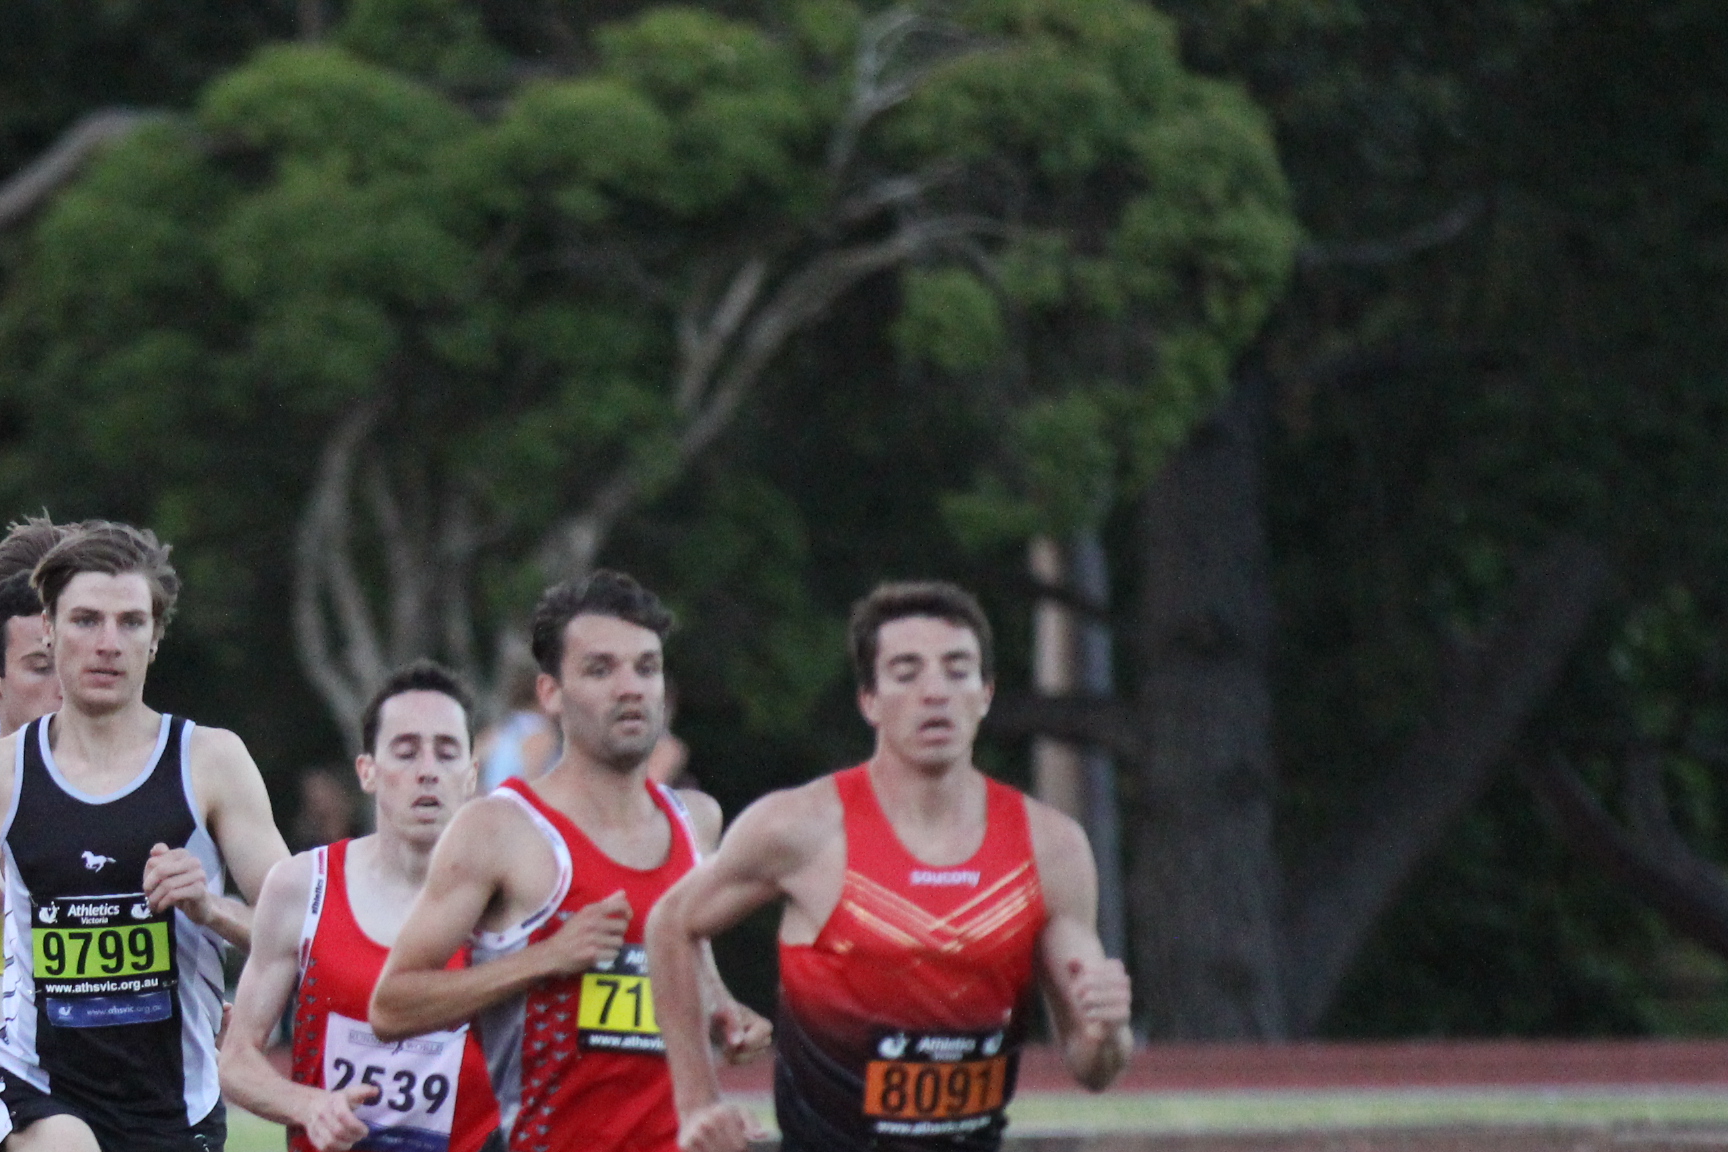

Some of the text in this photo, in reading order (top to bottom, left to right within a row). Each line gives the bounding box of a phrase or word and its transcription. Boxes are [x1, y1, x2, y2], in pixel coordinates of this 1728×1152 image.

[67, 903, 120, 917] Athletics
[81, 916, 109, 925] Victoria
[43, 927, 154, 976] 9799
[45, 978, 159, 993] www.athsvic.org.au
[332, 1057, 451, 1115] 2539
[881, 1064, 994, 1114] 8091
